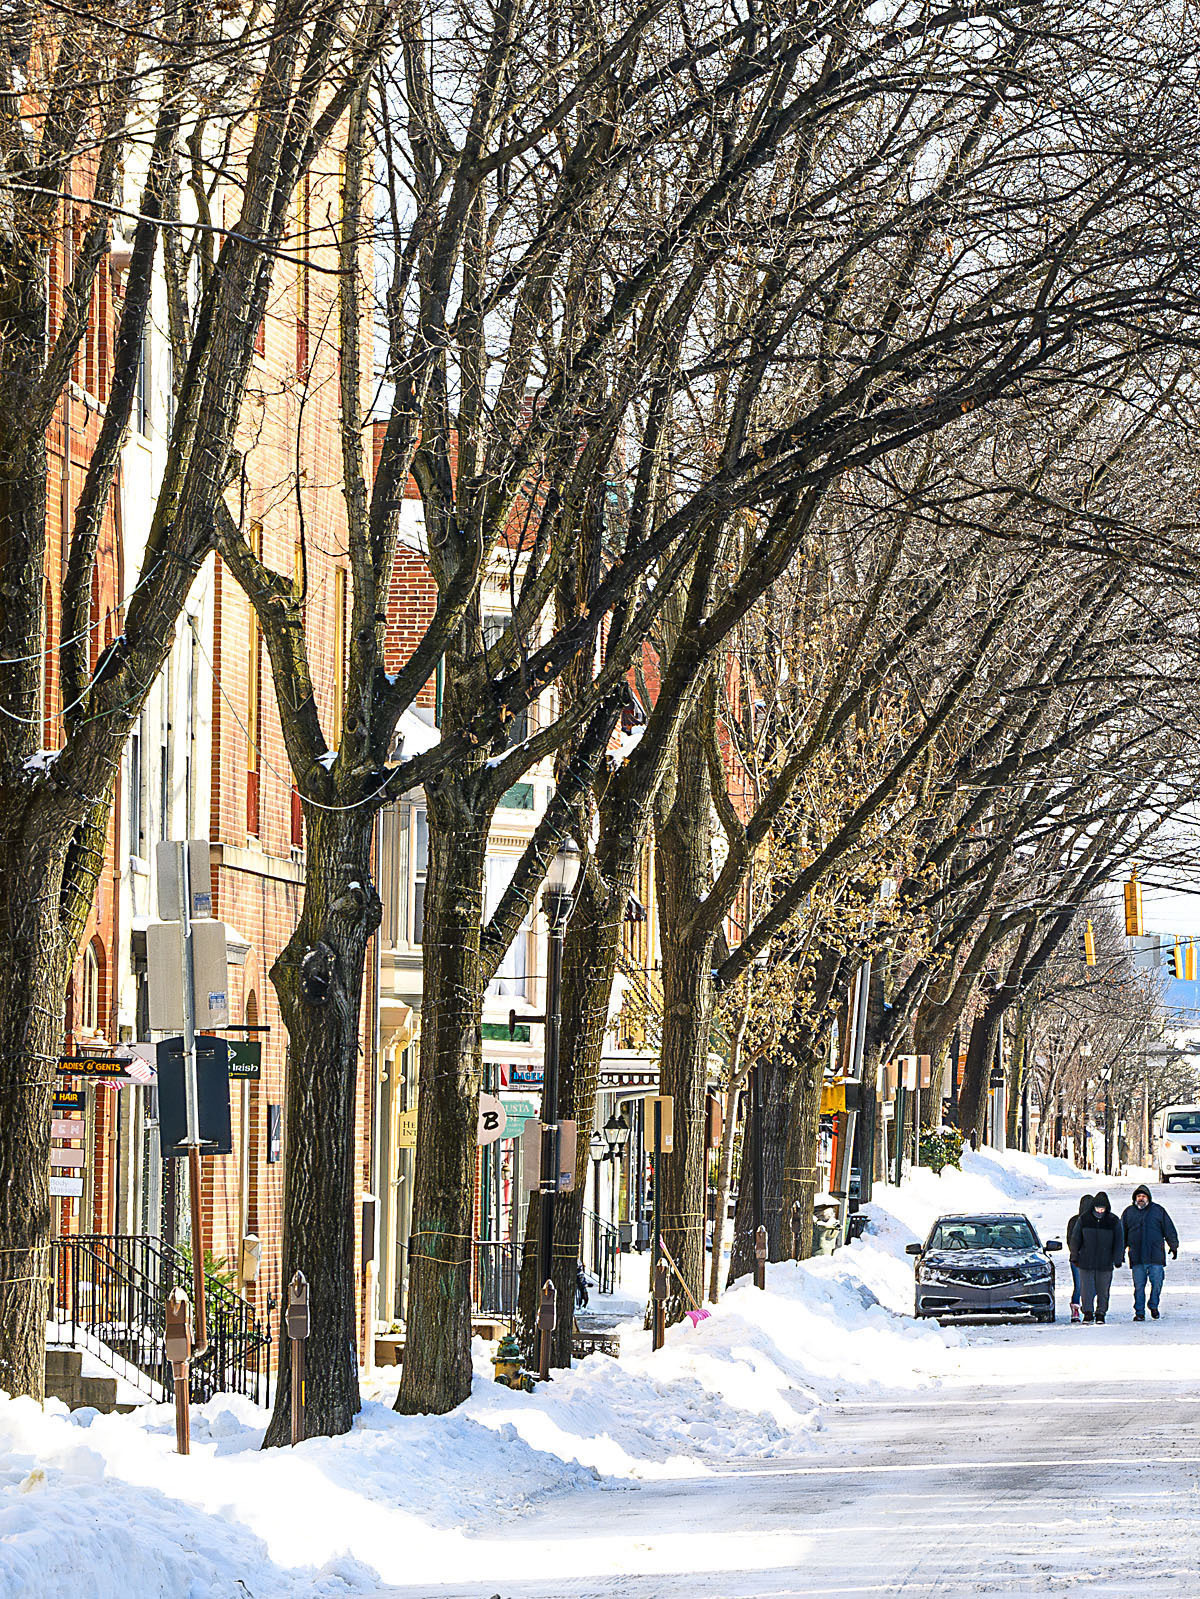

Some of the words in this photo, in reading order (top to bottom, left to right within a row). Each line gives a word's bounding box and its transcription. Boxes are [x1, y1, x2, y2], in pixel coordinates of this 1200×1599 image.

[58, 1061, 84, 1070] LADIES
[95, 1063, 121, 1072] GENTS
[232, 1063, 259, 1072] Irish
[59, 1093, 78, 1101] HAIR
